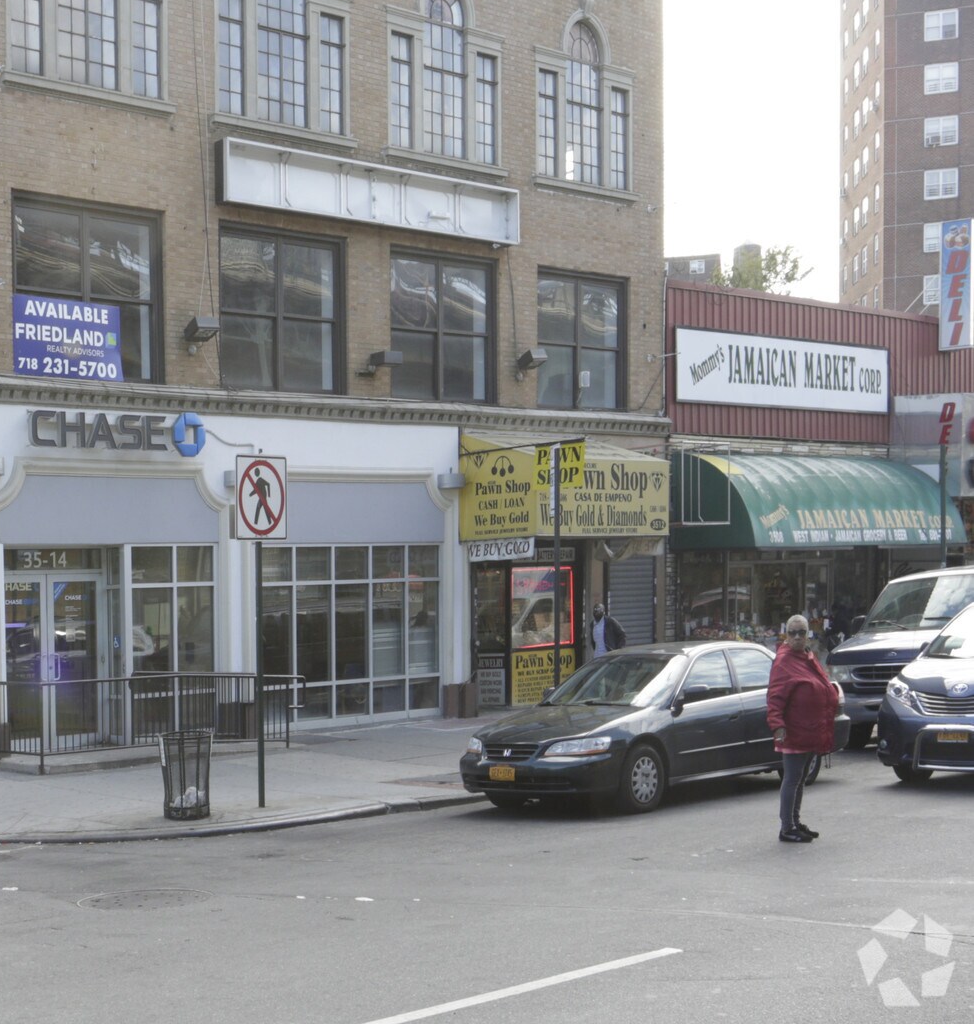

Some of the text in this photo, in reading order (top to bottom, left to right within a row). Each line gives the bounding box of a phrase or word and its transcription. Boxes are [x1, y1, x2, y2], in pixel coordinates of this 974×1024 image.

[945, 250, 969, 346] DELI
[24, 300, 109, 324] AVAILABLE
[14, 322, 104, 347] FRIEDLAND
[46, 344, 105, 358] REALTY ADVISORS
[18, 356, 117, 379] 718 231-5700
[688, 344, 882, 395] Mommy's JAMAICAN MARKET CORP.
[29, 409, 168, 452] CHASE
[475, 479, 531, 496] Pawn Shop
[610, 463, 648, 499] Shop
[478, 499, 498, 510] CASH
[504, 497, 525, 509] LOAN
[574, 492, 592, 502] CASA
[593, 492, 603, 502] DE
[605, 493, 632, 503] EMPENO
[474, 511, 529, 527] We Buy Gold
[576, 504, 595, 527] Gold
[597, 504, 604, 526] &
[607, 504, 648, 527] Diamonds
[797, 509, 870, 529] JAMAICAN
[872, 509, 926, 529] MARKET
[929, 515, 955, 529] COP.
[23, 551, 67, 568] 35-14
[483, 543, 503, 556] BUY
[515, 652, 572, 669] Pawn Sop
